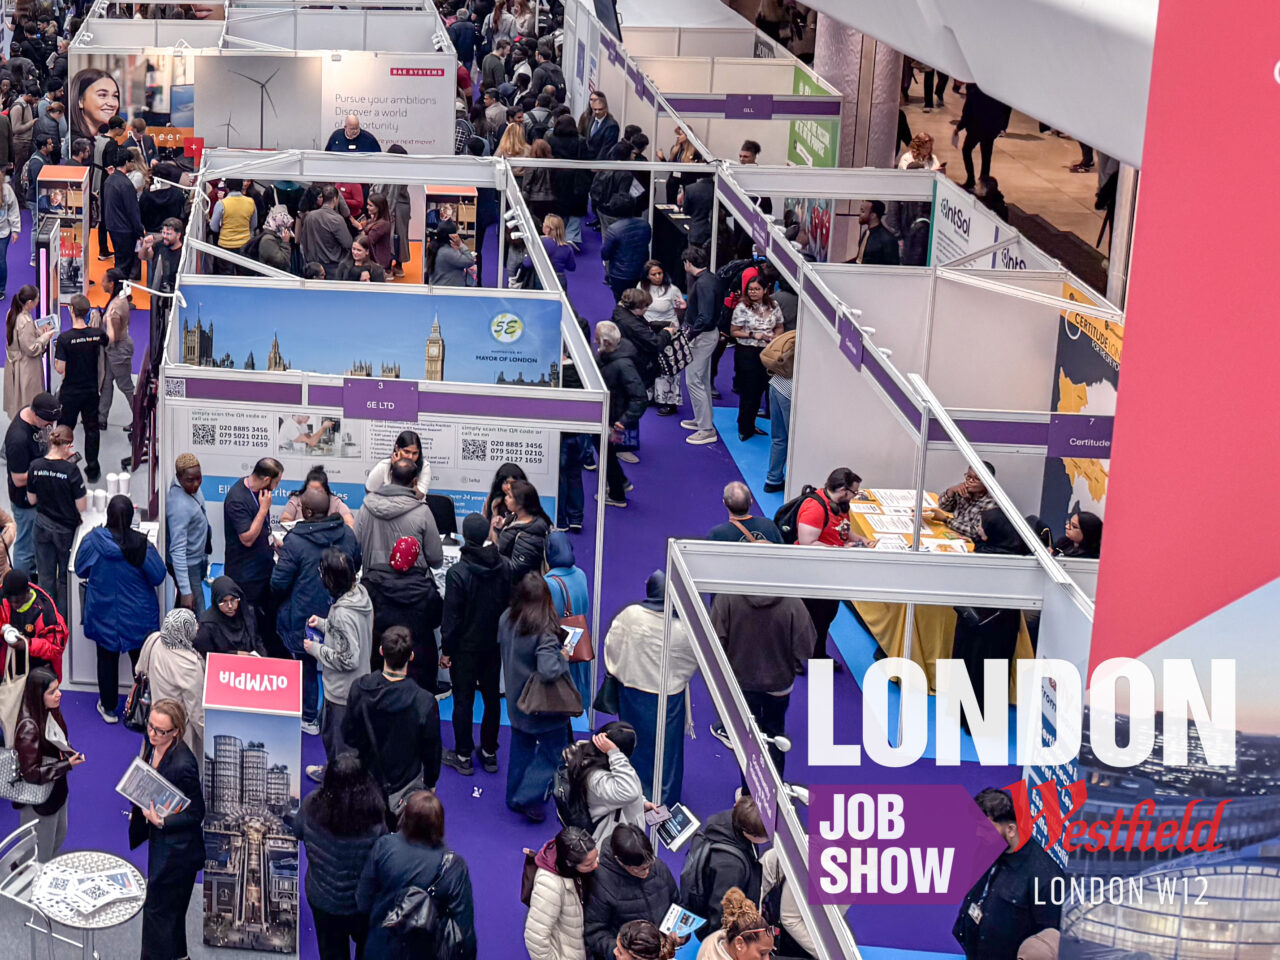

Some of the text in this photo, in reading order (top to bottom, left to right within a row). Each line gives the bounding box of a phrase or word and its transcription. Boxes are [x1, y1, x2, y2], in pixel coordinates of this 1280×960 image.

[335, 94, 436, 106] Pursue your ambitions
[335, 107, 407, 117] Discover world
[1074, 312, 1108, 349] CERTITUDE
[1070, 438, 1110, 447] Certitude
[219, 670, 288, 691] OLYMPIA
